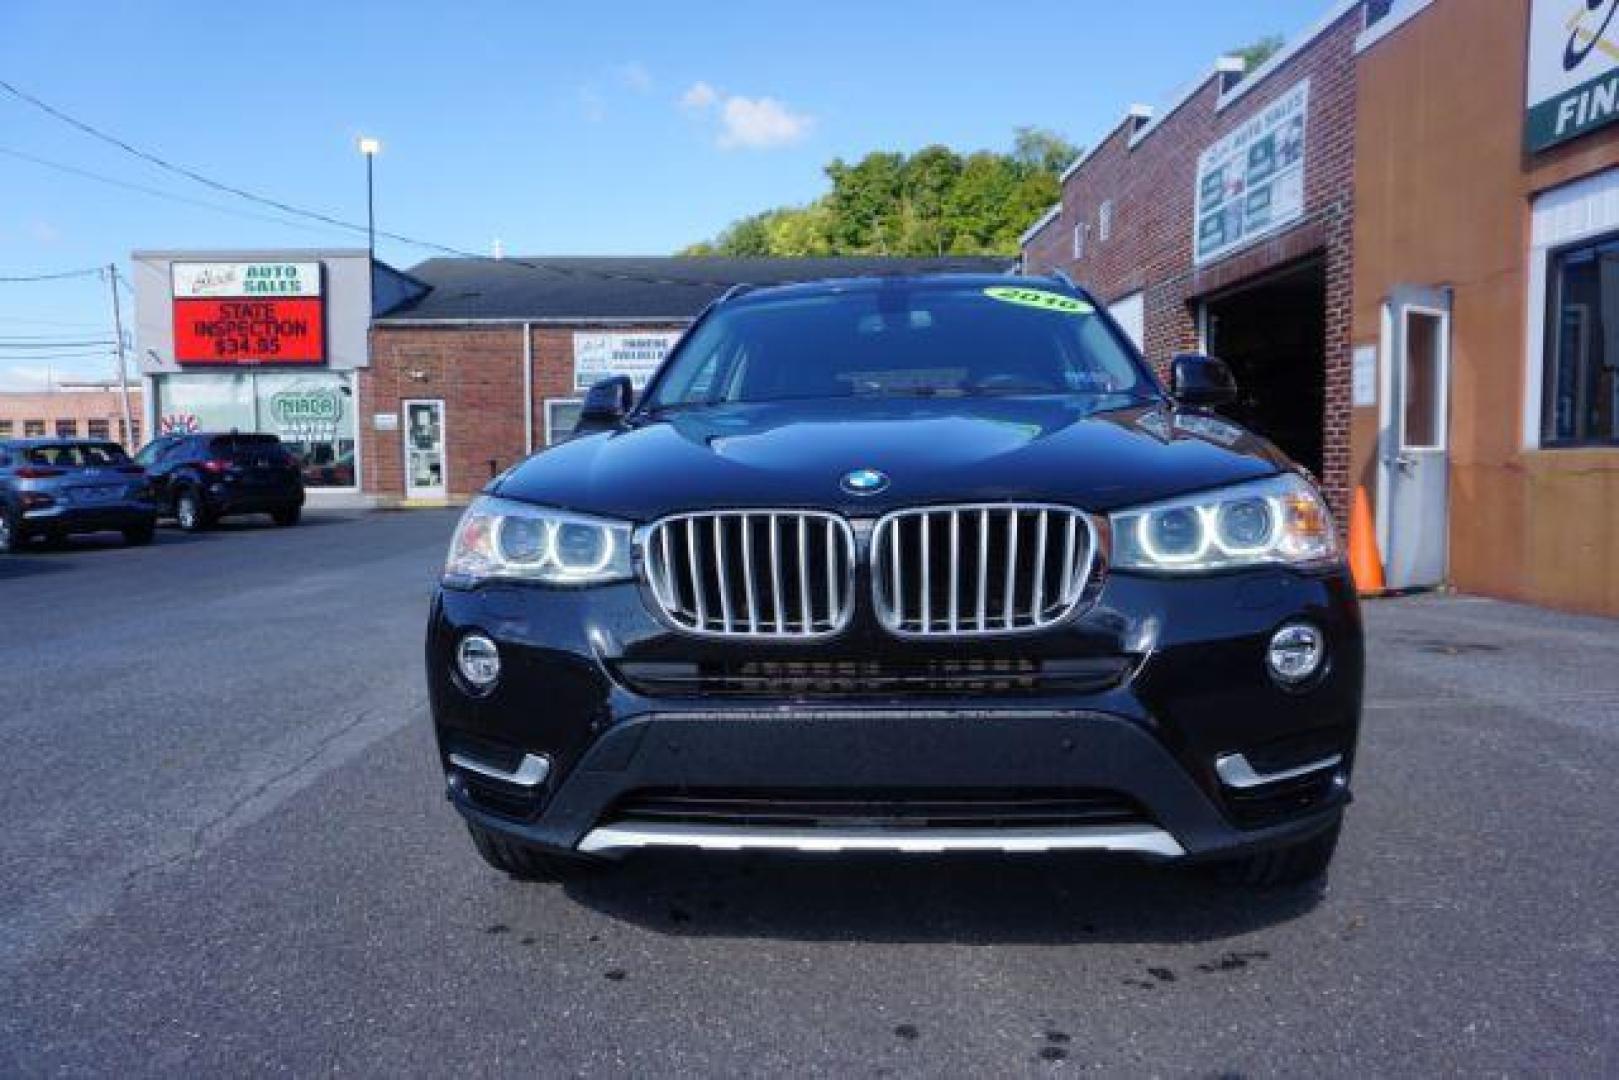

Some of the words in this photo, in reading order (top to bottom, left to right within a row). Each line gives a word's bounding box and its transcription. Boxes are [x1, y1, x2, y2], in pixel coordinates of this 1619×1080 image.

[1555, 79, 1619, 136] FIN
[247, 265, 298, 278] AUTO
[242, 279, 302, 293] SALES
[219, 303, 276, 320] STATE
[193, 319, 308, 338] INSPECTION
